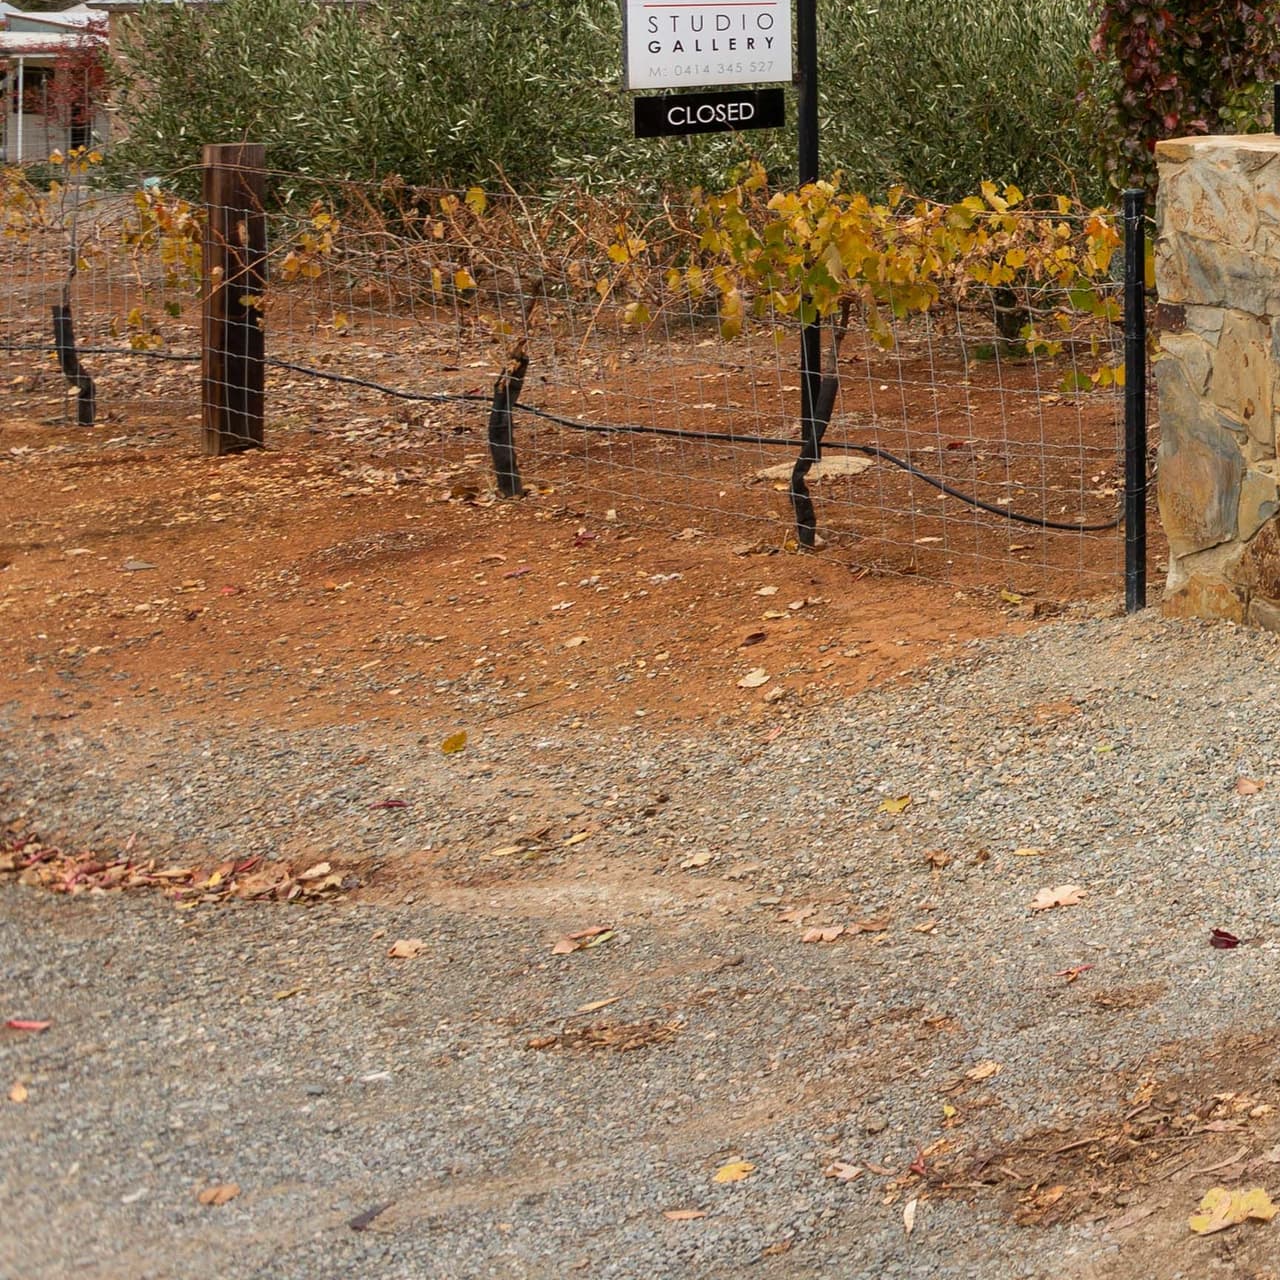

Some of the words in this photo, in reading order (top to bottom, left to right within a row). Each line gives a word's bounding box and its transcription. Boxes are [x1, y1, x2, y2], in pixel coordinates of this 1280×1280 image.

[648, 13, 774, 33] STUDIO
[648, 37, 774, 53] GALLERY
[649, 67, 668, 78] M:
[674, 64, 710, 76] 0414
[717, 62, 743, 74] 345
[749, 61, 774, 73] 527
[667, 102, 755, 125] CLOSED
